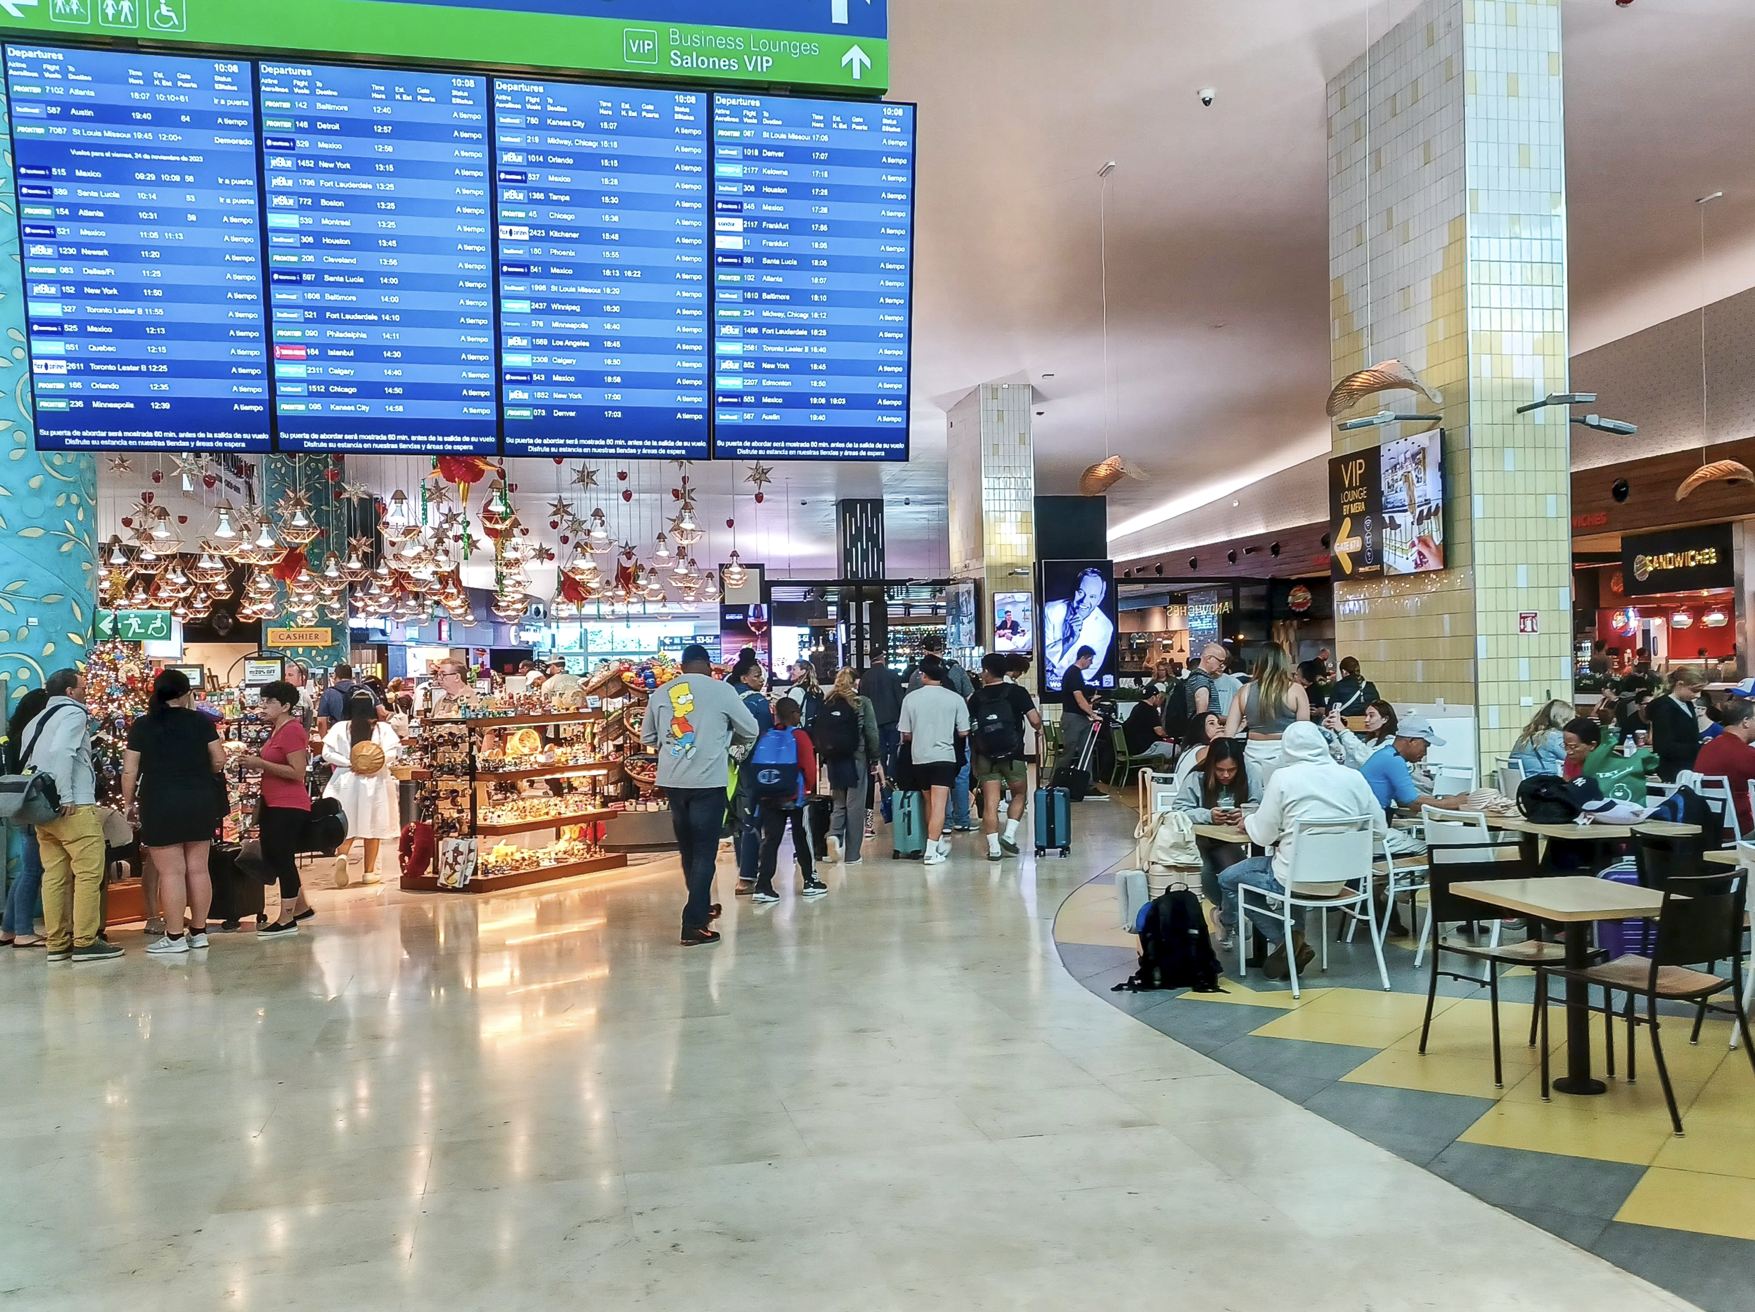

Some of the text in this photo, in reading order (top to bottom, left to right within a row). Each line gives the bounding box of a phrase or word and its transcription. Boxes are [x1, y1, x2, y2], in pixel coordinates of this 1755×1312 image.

[630, 40, 653, 53] VIP
[669, 28, 819, 57] Business Lounges
[7, 47, 64, 60] Departures
[670, 51, 773, 72] Salones VIP
[260, 64, 312, 76] Departures
[451, 78, 475, 88] 10:08
[495, 81, 544, 92] Departures
[69, 87, 95, 96] Atlanta
[715, 96, 760, 107] Departures
[316, 102, 348, 111] Baltimore
[70, 107, 94, 116] Austin
[458, 111, 481, 120] tiempo
[223, 118, 248, 127] tiempo
[316, 121, 340, 130] Detroit
[214, 136, 252, 145] Demorado
[317, 141, 342, 149] Mexico
[335, 161, 351, 169] York
[680, 164, 702, 172] tiempo
[75, 169, 102, 177] Mexico
[76, 189, 99, 197] Santa
[320, 198, 344, 207] Boston
[78, 208, 104, 217] Atlanta
[79, 228, 106, 236] Mexico
[322, 236, 351, 245] Houston
[80, 248, 109, 256] Newark
[322, 255, 356, 264] Cleveland
[324, 293, 356, 301] Baltimore
[340, 312, 378, 321] Lauderdale
[86, 325, 113, 333] Mexico
[328, 367, 354, 375] Calgary
[328, 385, 357, 394] Chicago
[91, 400, 134, 409] Minneapolis
[356, 404, 369, 412] City
[1341, 459, 1365, 488] VIP
[1340, 487, 1367, 503] LOUNGE
[1343, 504, 1365, 515] BY MERA
[1645, 547, 1717, 572] SANDWICHES
